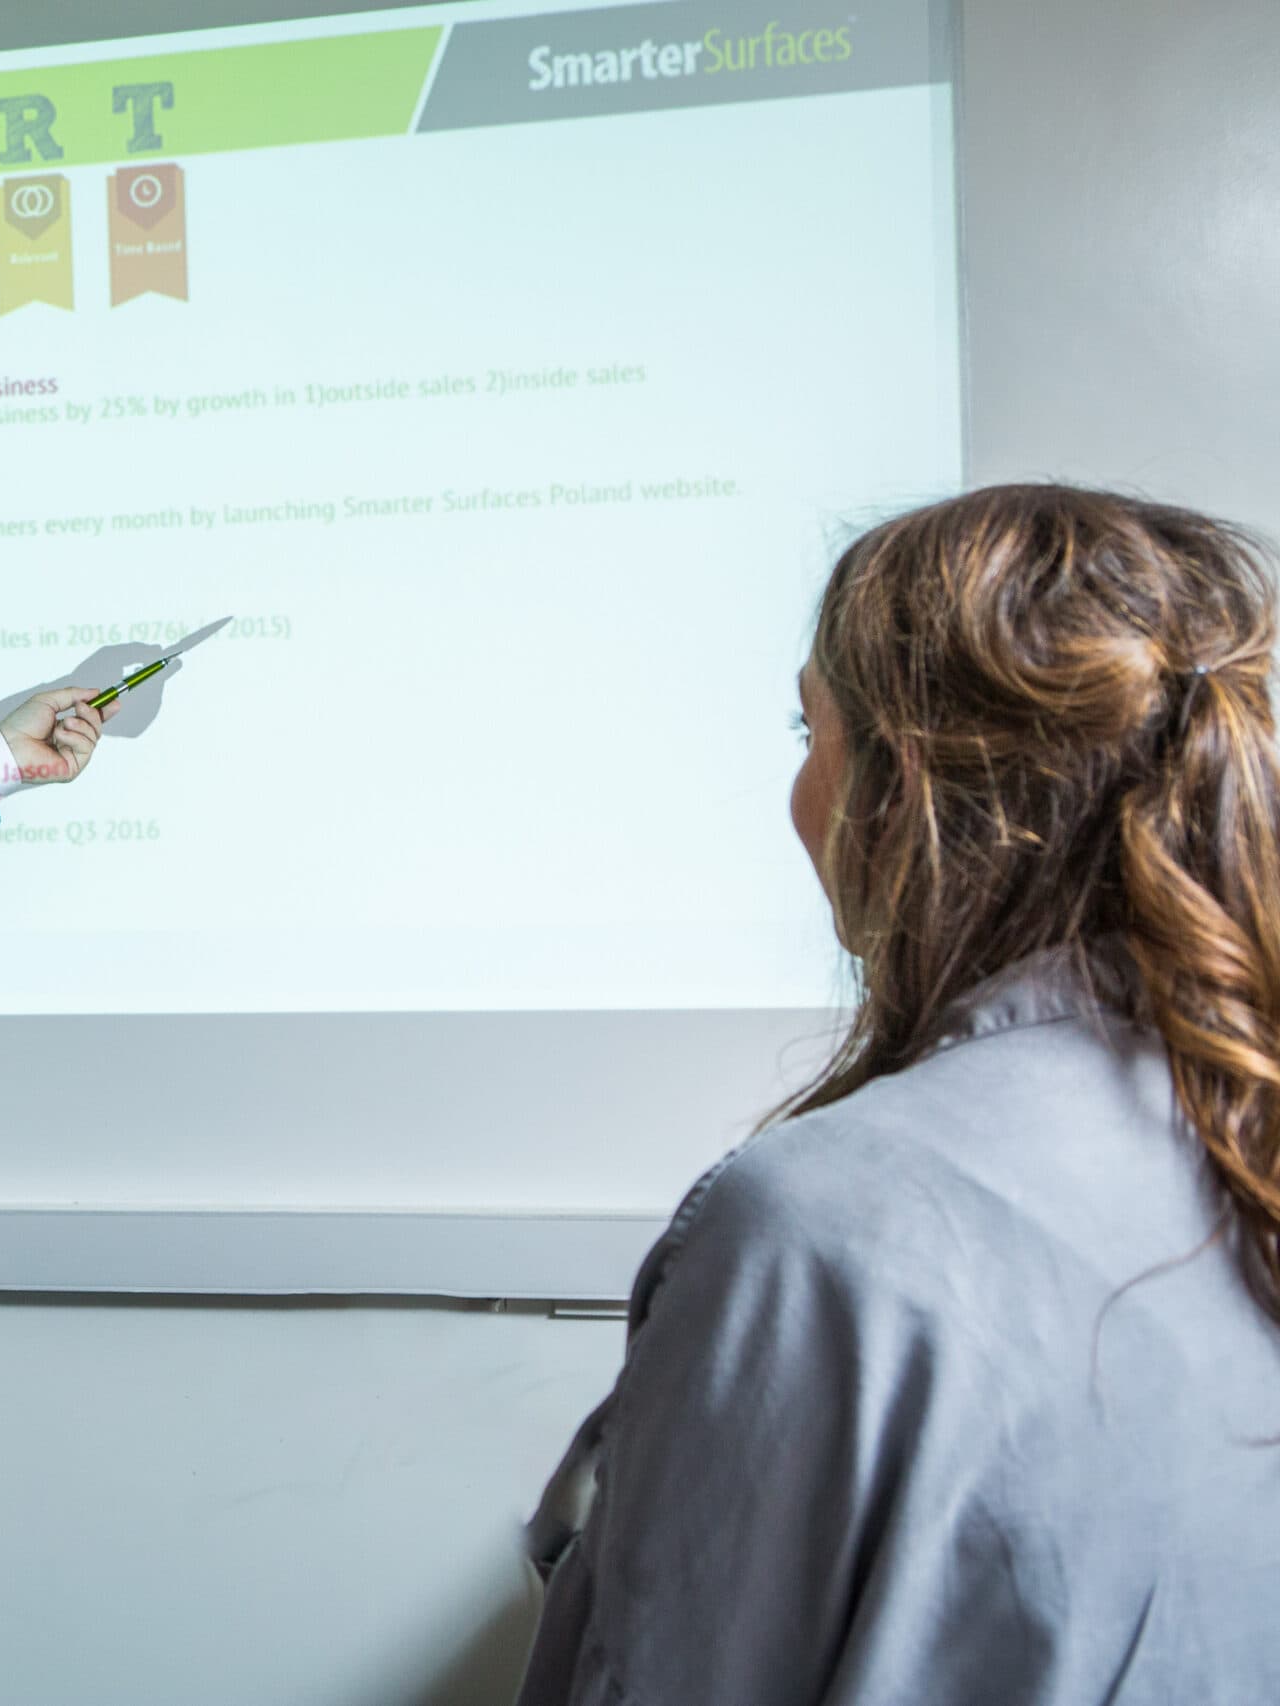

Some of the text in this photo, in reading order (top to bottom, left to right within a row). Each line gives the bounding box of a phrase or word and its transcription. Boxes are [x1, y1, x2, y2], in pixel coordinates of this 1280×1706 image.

[66, 400, 93, 424] by
[100, 395, 145, 420] 25%
[154, 393, 180, 417] by
[187, 386, 267, 418] growth
[274, 384, 296, 406] in
[418, 373, 476, 396] sales
[586, 363, 646, 386] sales
[45, 512, 104, 538] every
[111, 506, 183, 531] month
[190, 502, 217, 529] by
[223, 496, 336, 528] launching
[343, 491, 434, 518] Smarter
[442, 486, 543, 512] Surfaces
[550, 480, 632, 506] Poland
[639, 473, 743, 501] website.
[39, 626, 61, 648] in
[66, 623, 122, 647] 2016
[65, 819, 98, 846] Q3
[105, 817, 162, 841] 2016
